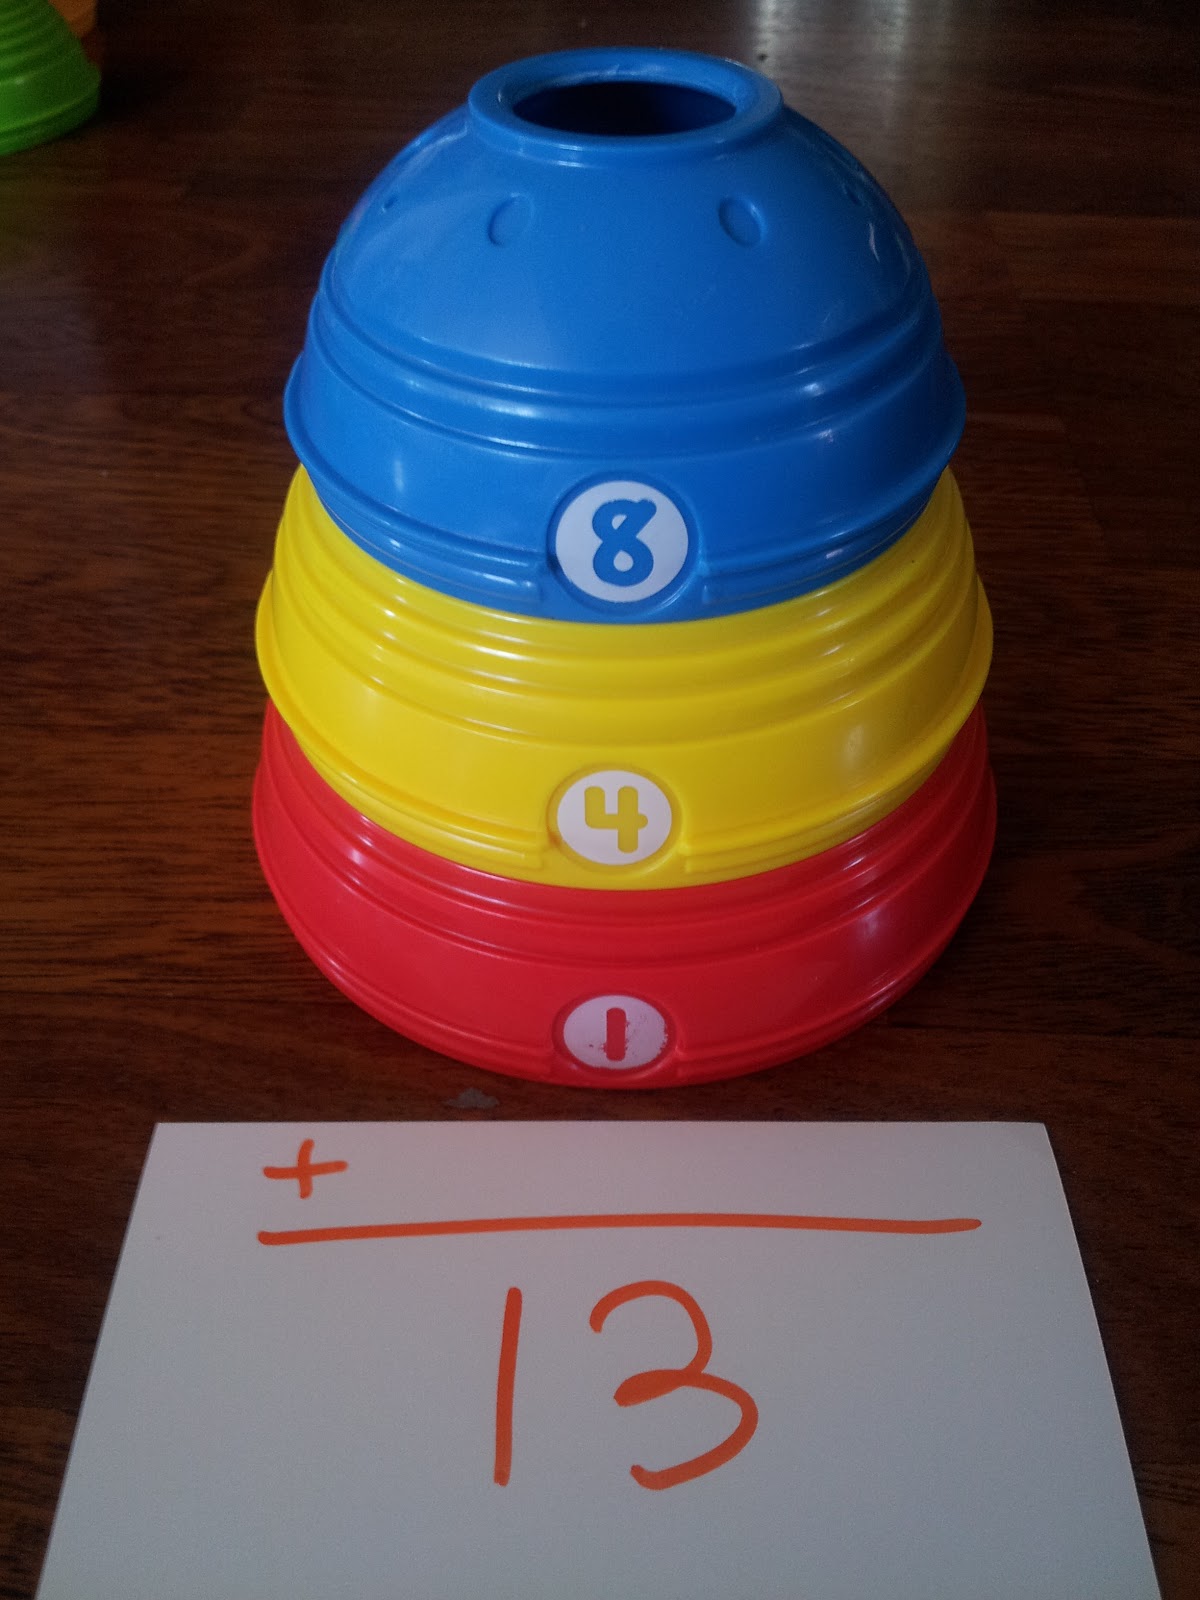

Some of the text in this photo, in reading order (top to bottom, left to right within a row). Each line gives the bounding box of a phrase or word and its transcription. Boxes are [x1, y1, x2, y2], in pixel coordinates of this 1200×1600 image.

[592, 498, 657, 588] 8
[584, 786, 648, 854] 4
[605, 1007, 627, 1062] 1
[494, 1280, 759, 1490] 13
